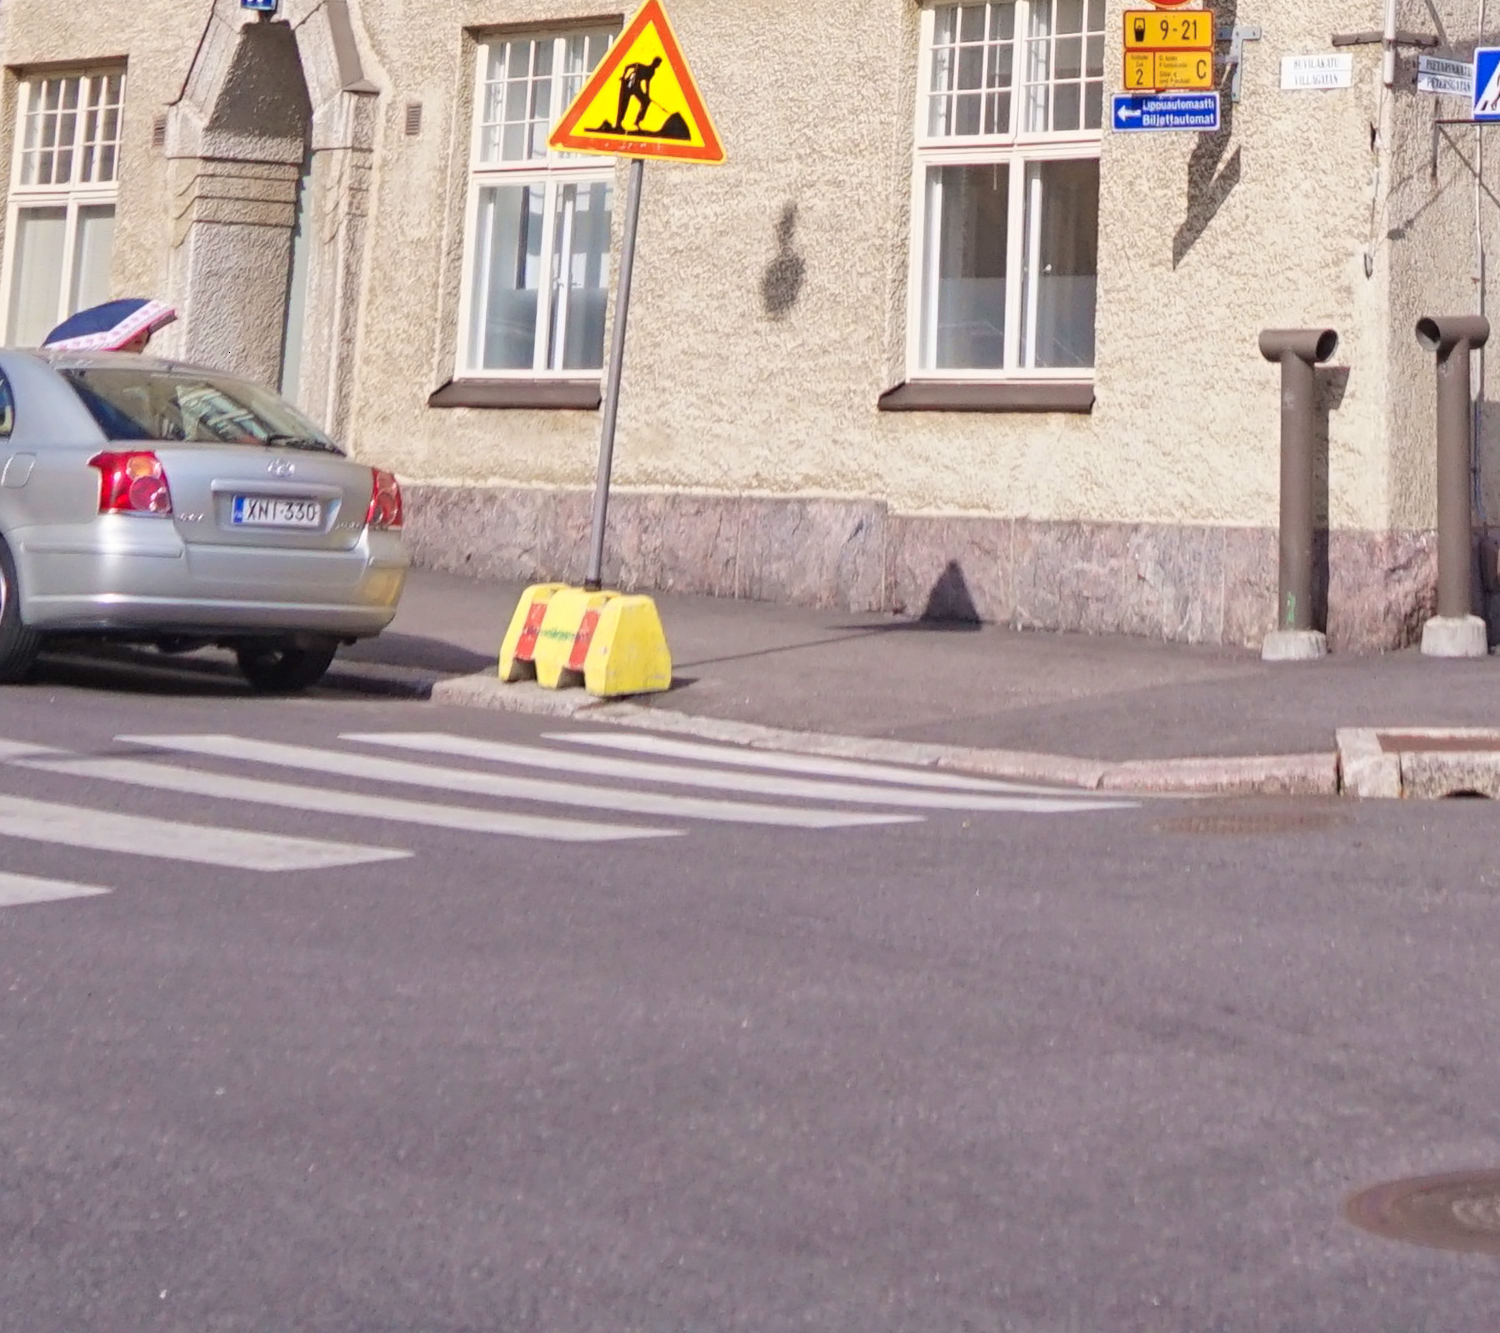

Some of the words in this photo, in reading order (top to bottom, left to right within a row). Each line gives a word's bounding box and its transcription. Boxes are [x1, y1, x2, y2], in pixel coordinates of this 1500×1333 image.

[1135, 68, 1144, 86] 2
[1196, 59, 1207, 80] C
[1142, 98, 1215, 111] Lippuautomaatti
[1141, 113, 1215, 127] Biljettautomat
